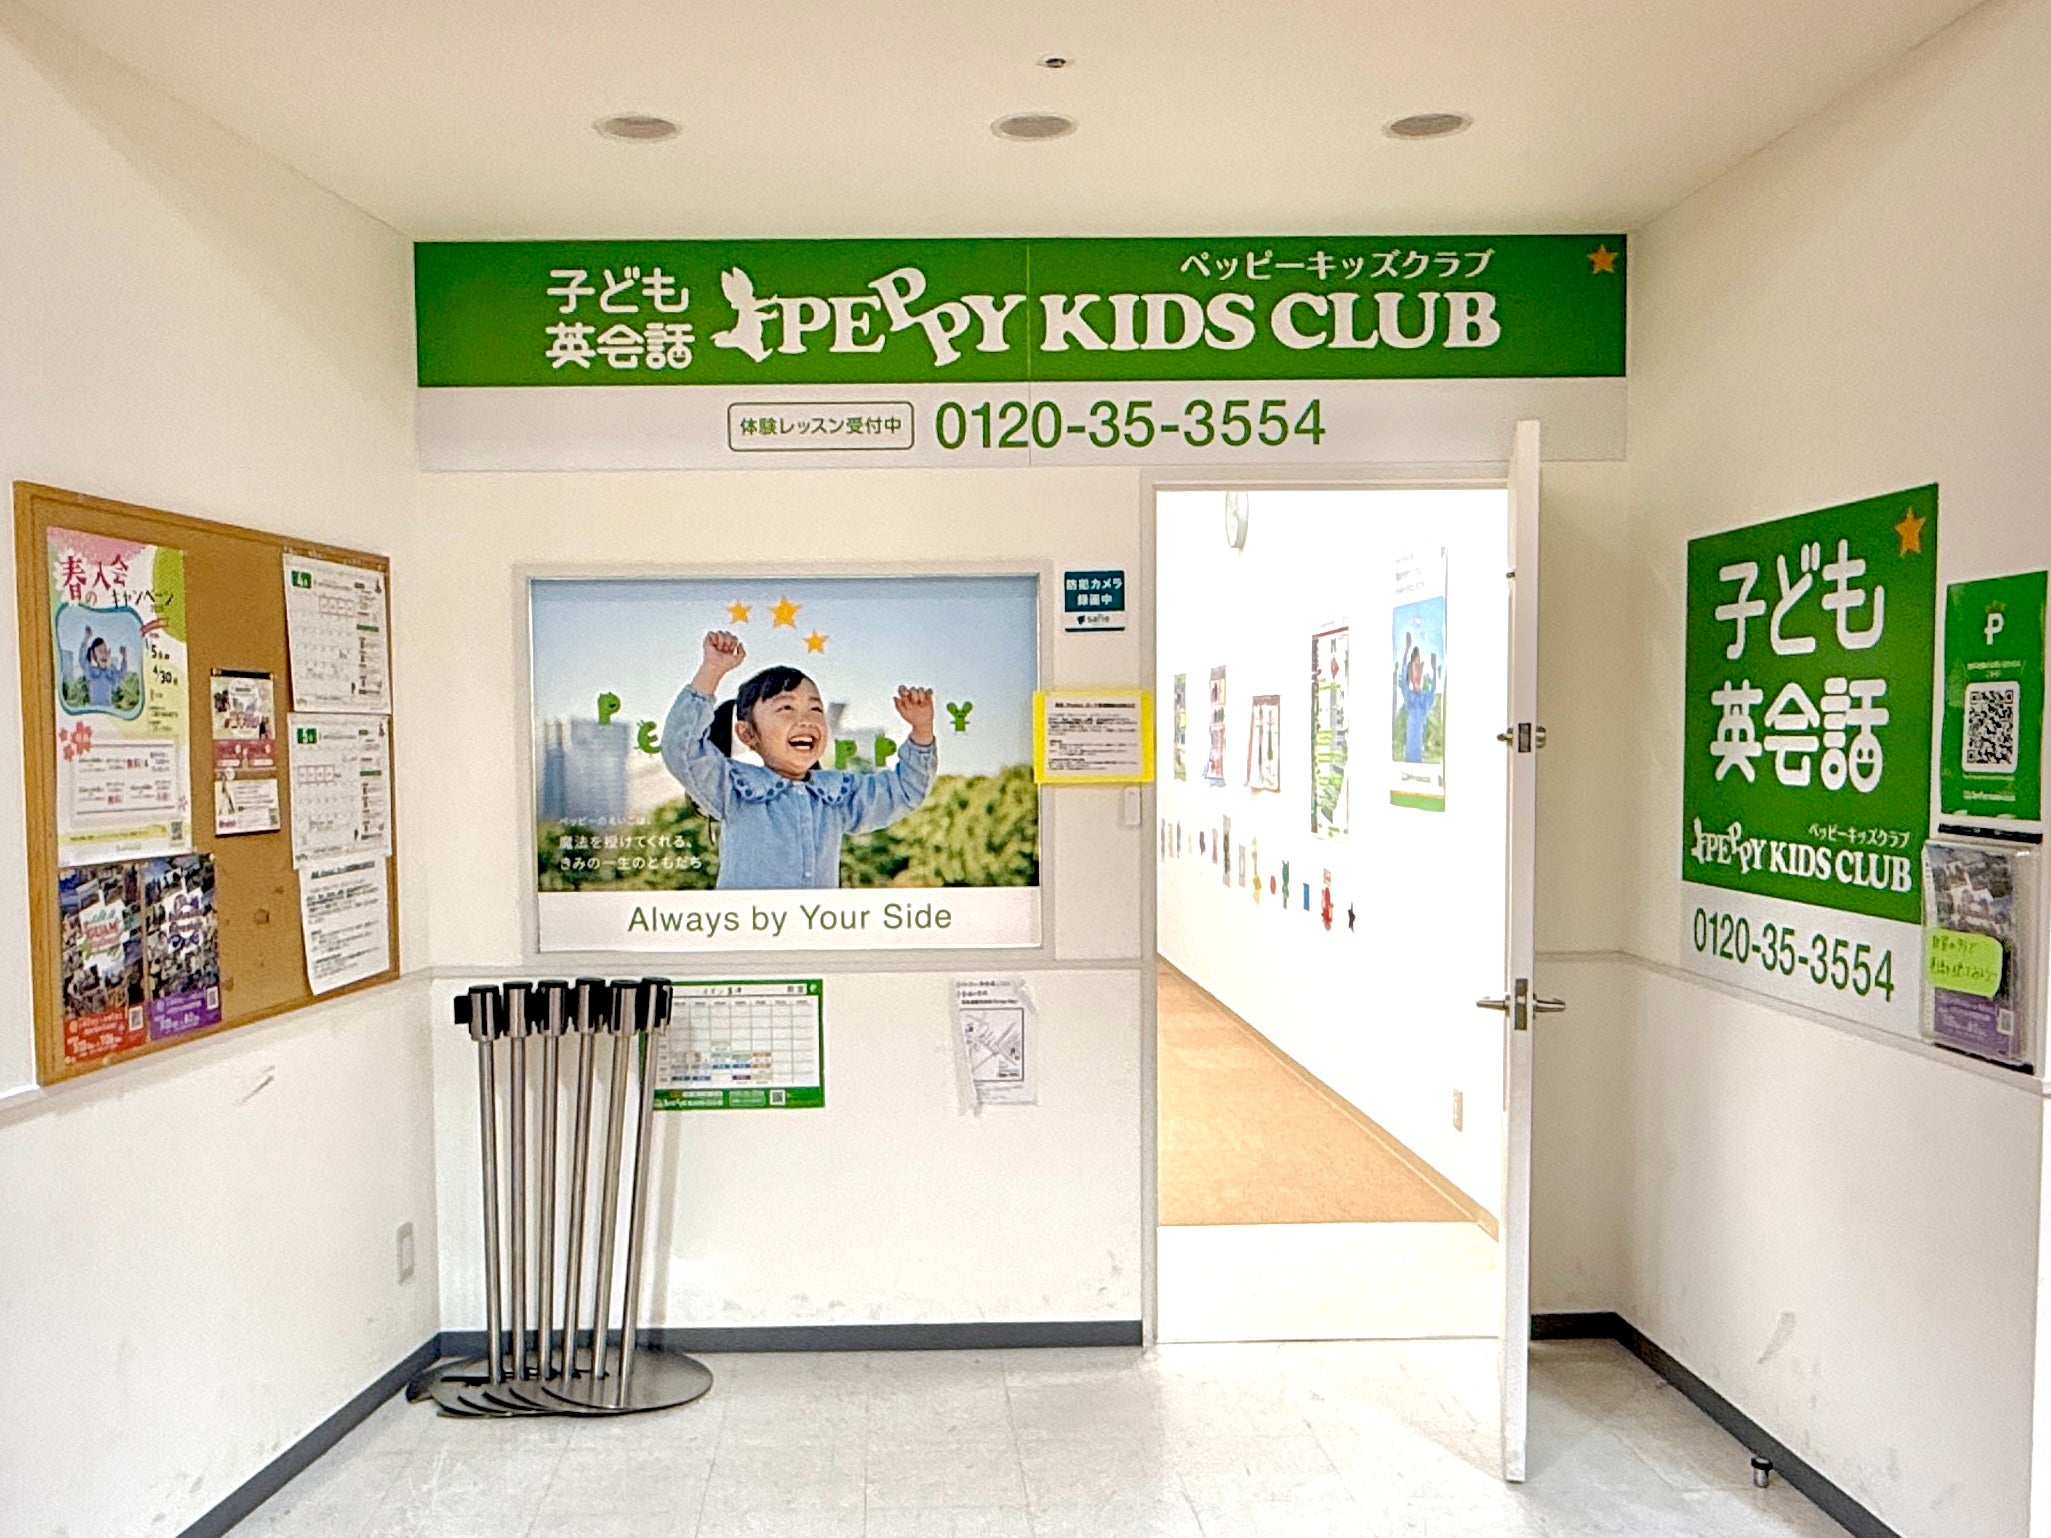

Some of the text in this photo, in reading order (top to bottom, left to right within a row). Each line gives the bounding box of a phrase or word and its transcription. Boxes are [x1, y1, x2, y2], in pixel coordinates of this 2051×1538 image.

[1180, 248, 1496, 281] ペッピーキッズクラブ
[546, 266, 690, 315] 子ども
[778, 266, 1502, 368] PEPPY KIDS CLUB
[545, 321, 696, 370] 英会話
[740, 416, 902, 436] 体験レッスン受付中
[935, 399, 1327, 449] 0120-35-3554
[1066, 577, 1123, 591] 防犯カメラ
[1714, 538, 1886, 660] 子ども
[1709, 676, 1890, 793] 英会話
[1704, 821, 1913, 893] PEPPY KIDS CLUB
[1808, 822, 1911, 849] ペッピーキッズクラブ
[560, 856, 702, 871] きみの一生のともだち
[628, 902, 952, 938] Always by Your Side
[1694, 907, 1894, 1003] 0120-35-3554
